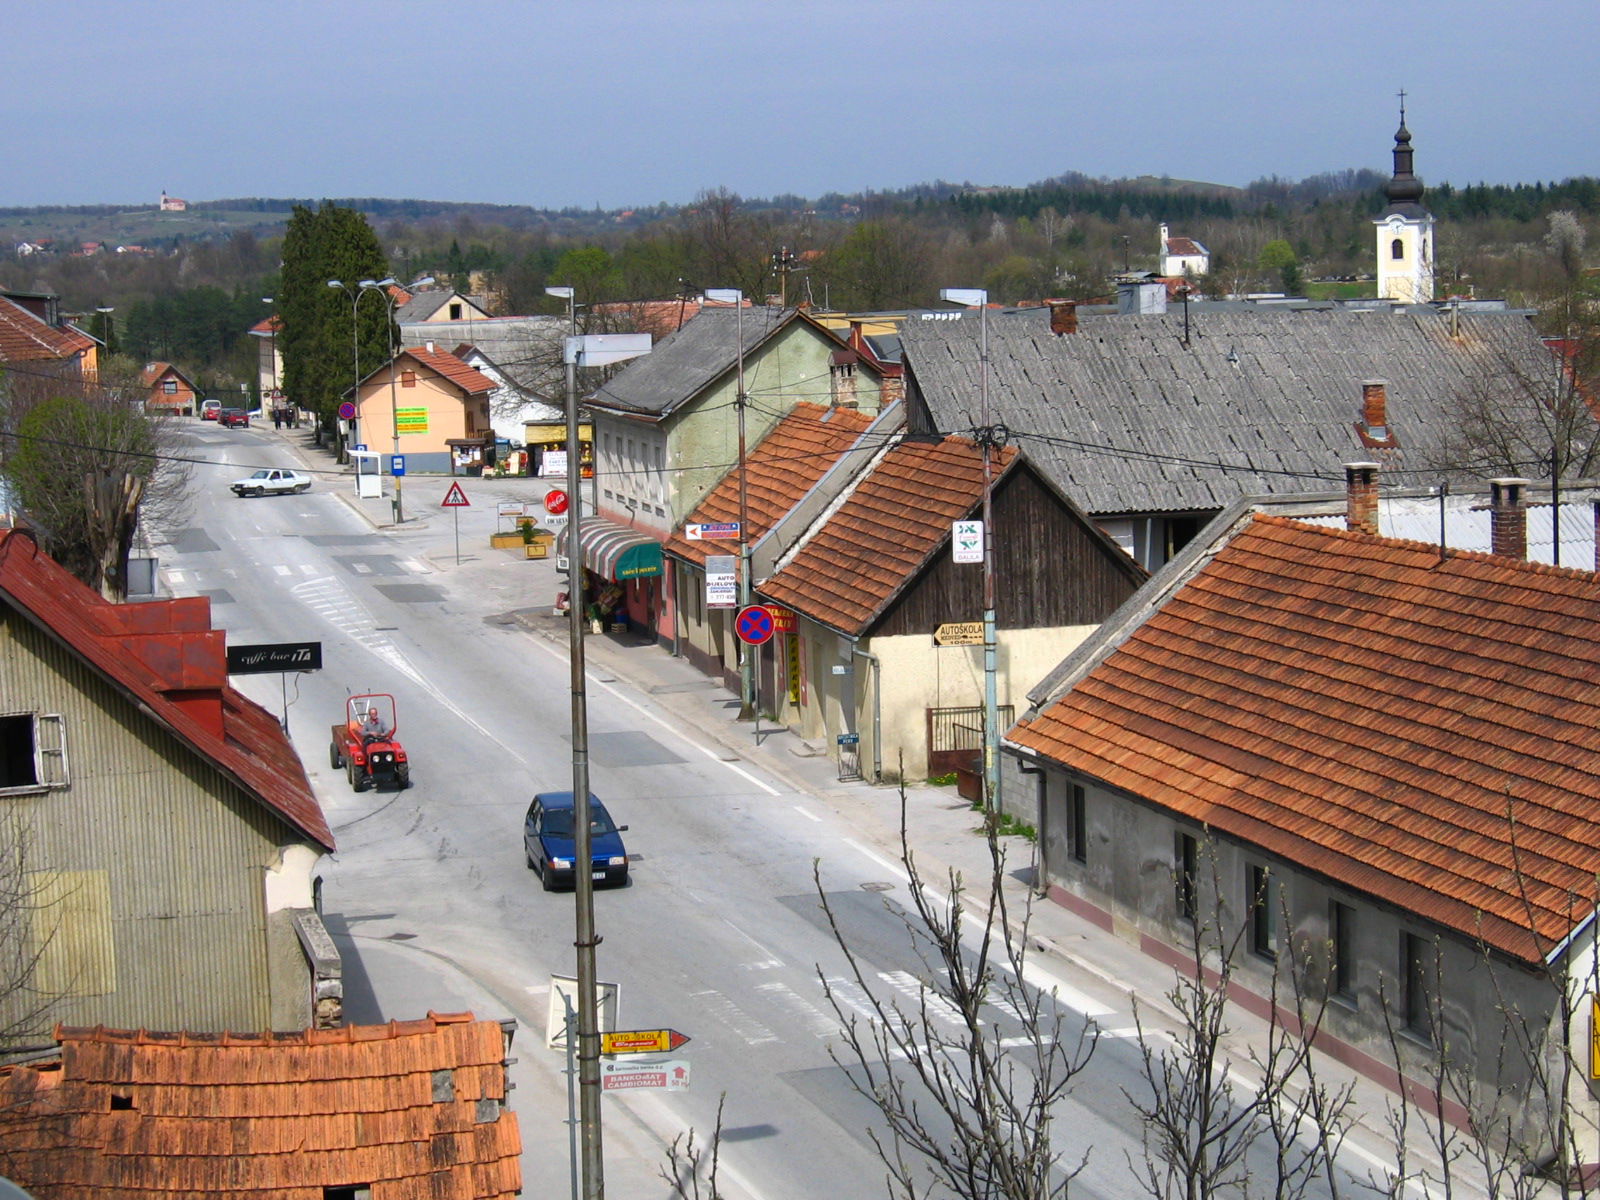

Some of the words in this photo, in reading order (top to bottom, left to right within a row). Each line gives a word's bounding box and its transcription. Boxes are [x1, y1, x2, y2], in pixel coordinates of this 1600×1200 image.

[940, 624, 983, 635] AUTOŠKOLA
[270, 651, 291, 661] bar
[291, 648, 311, 662] ITA
[609, 1034, 630, 1042] AUTO
[610, 1074, 661, 1082] BANKOMAT
